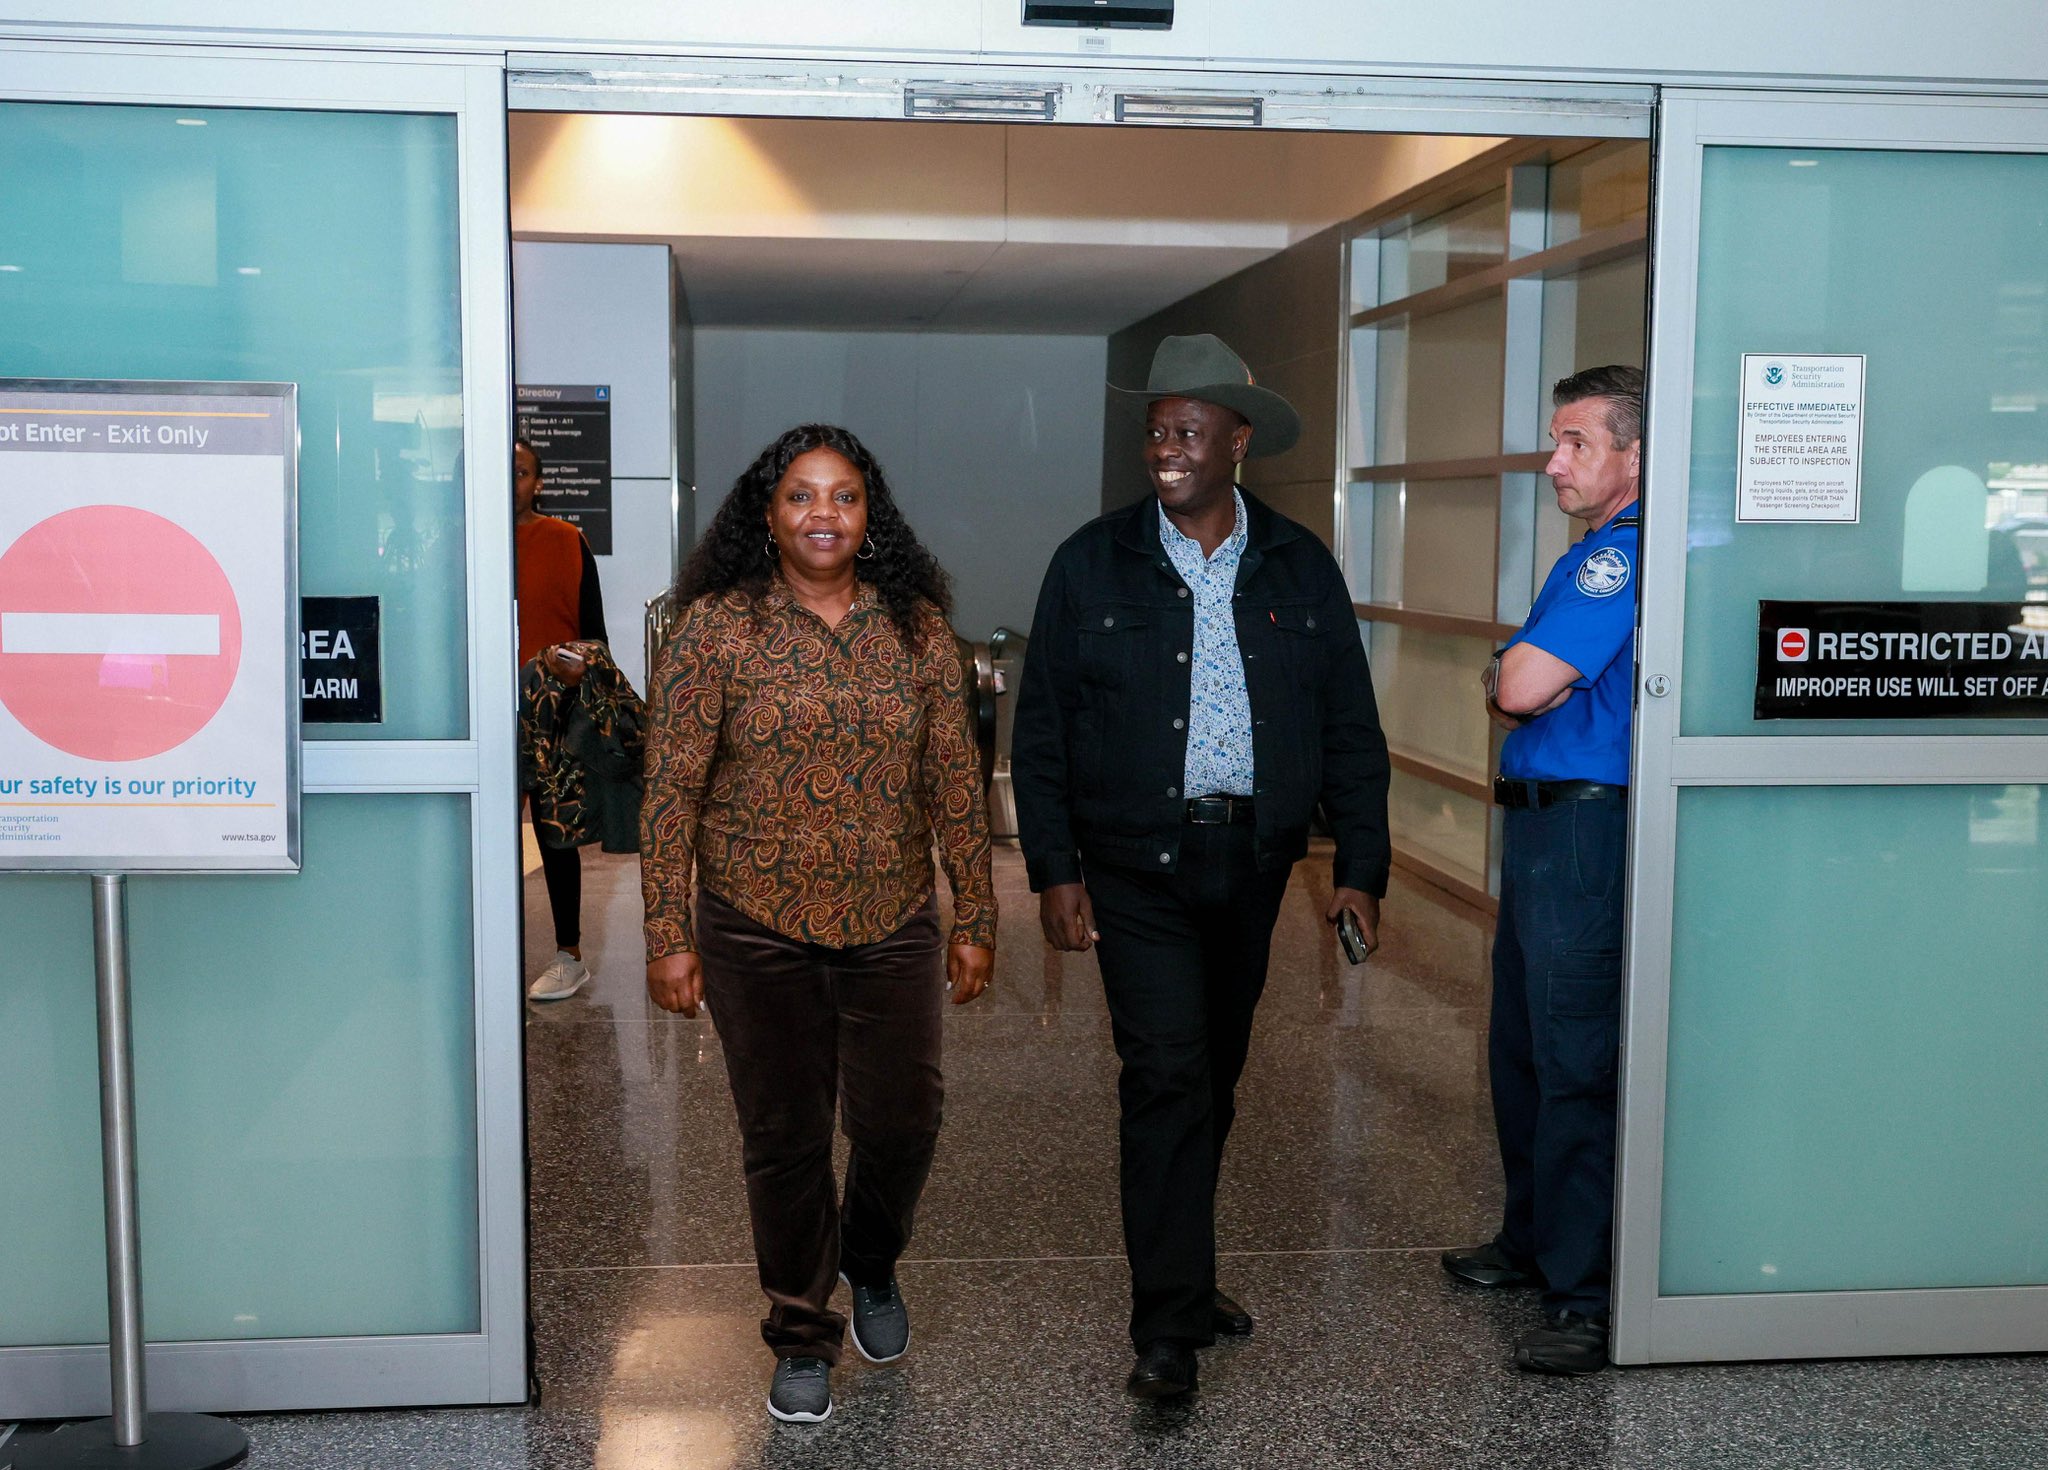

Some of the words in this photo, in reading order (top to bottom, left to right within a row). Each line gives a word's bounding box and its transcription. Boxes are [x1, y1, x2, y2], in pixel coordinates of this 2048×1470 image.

[1792, 364, 1844, 374] Transportation
[1792, 373, 1821, 381] Security
[518, 388, 562, 399] Directory
[598, 389, 605, 397] A
[1747, 402, 1794, 411] EFFECTIVE
[1797, 403, 1856, 411] IMMEDIATELY
[0, 423, 19, 442] ot
[26, 423, 86, 443] Enter
[108, 424, 151, 444] Exit
[157, 425, 209, 448] Only
[1755, 434, 1803, 443] EMPLOYEES
[1806, 435, 1847, 443] ENTERING
[1754, 445, 1770, 454] THE
[1772, 446, 1805, 454] STERILE
[1807, 446, 1829, 454] AREA
[1831, 446, 1847, 454] ARE
[1750, 457, 1787, 465] SUBJECT
[1789, 457, 1799, 465] TO
[1801, 457, 1851, 466] INSPECTION
[301, 630, 356, 659] EA
[1818, 632, 2012, 661] RESTRICTED
[2020, 632, 2048, 660] A
[302, 678, 358, 699] LARM
[1776, 677, 1870, 697] IMPROPER
[1876, 677, 1912, 697] USE
[1917, 677, 1959, 697] WILL
[1964, 676, 1998, 697] SET
[2003, 676, 2038, 697] OFF
[0, 779, 23, 795] ur
[30, 776, 97, 798] safety
[105, 776, 122, 795] is
[128, 779, 165, 795] our
[172, 777, 257, 799] priority
[222, 833, 276, 842] www.tsa.gov
